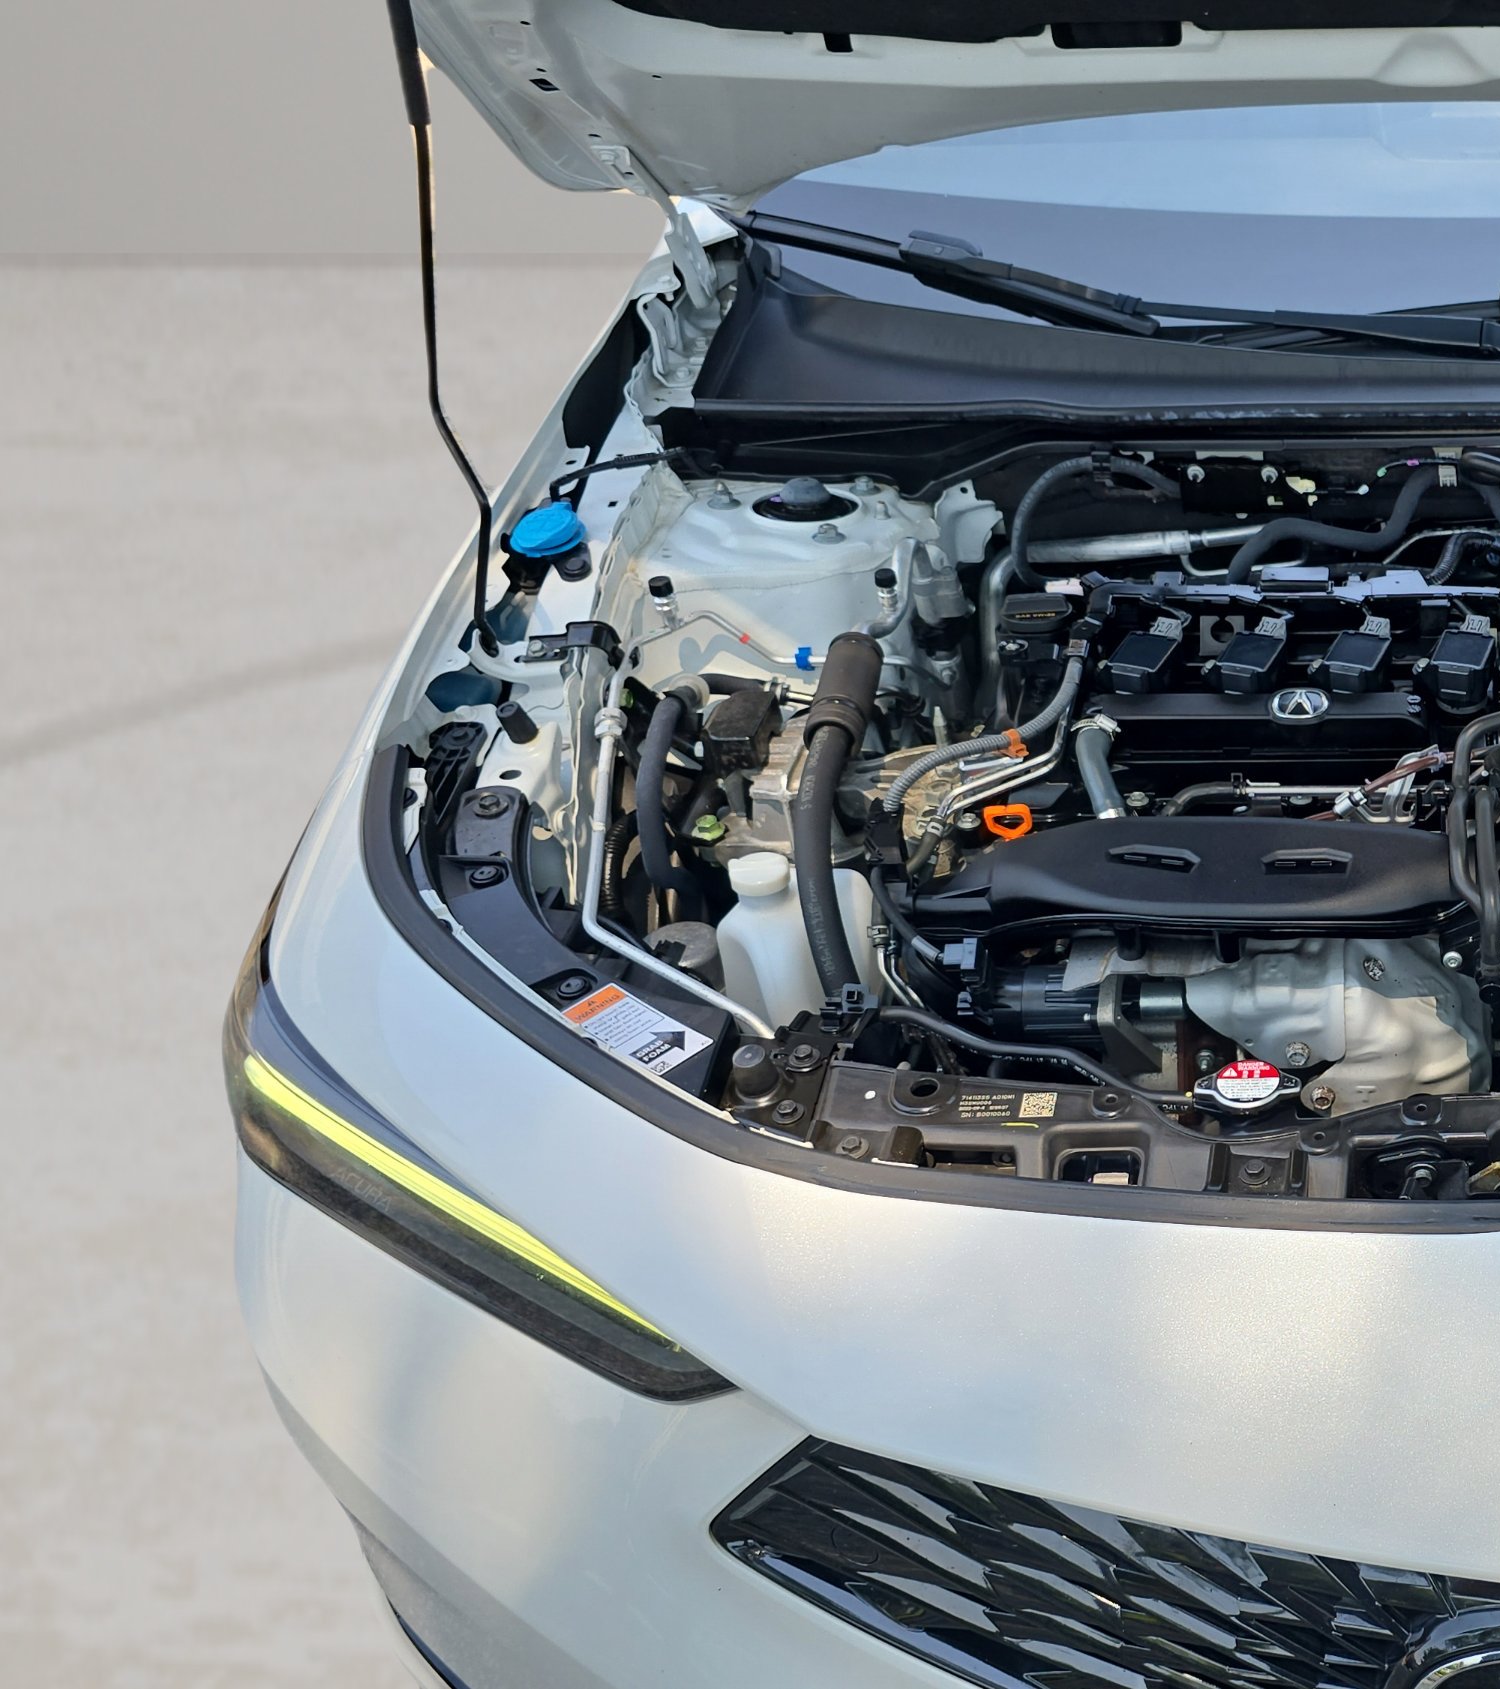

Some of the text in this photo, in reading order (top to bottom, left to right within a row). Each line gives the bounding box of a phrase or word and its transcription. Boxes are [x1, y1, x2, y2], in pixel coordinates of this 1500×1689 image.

[575, 994, 620, 1021] WARNING
[636, 1040, 664, 1057] GRAB
[642, 1043, 671, 1062] FOAM
[329, 1166, 392, 1213] ACURA
